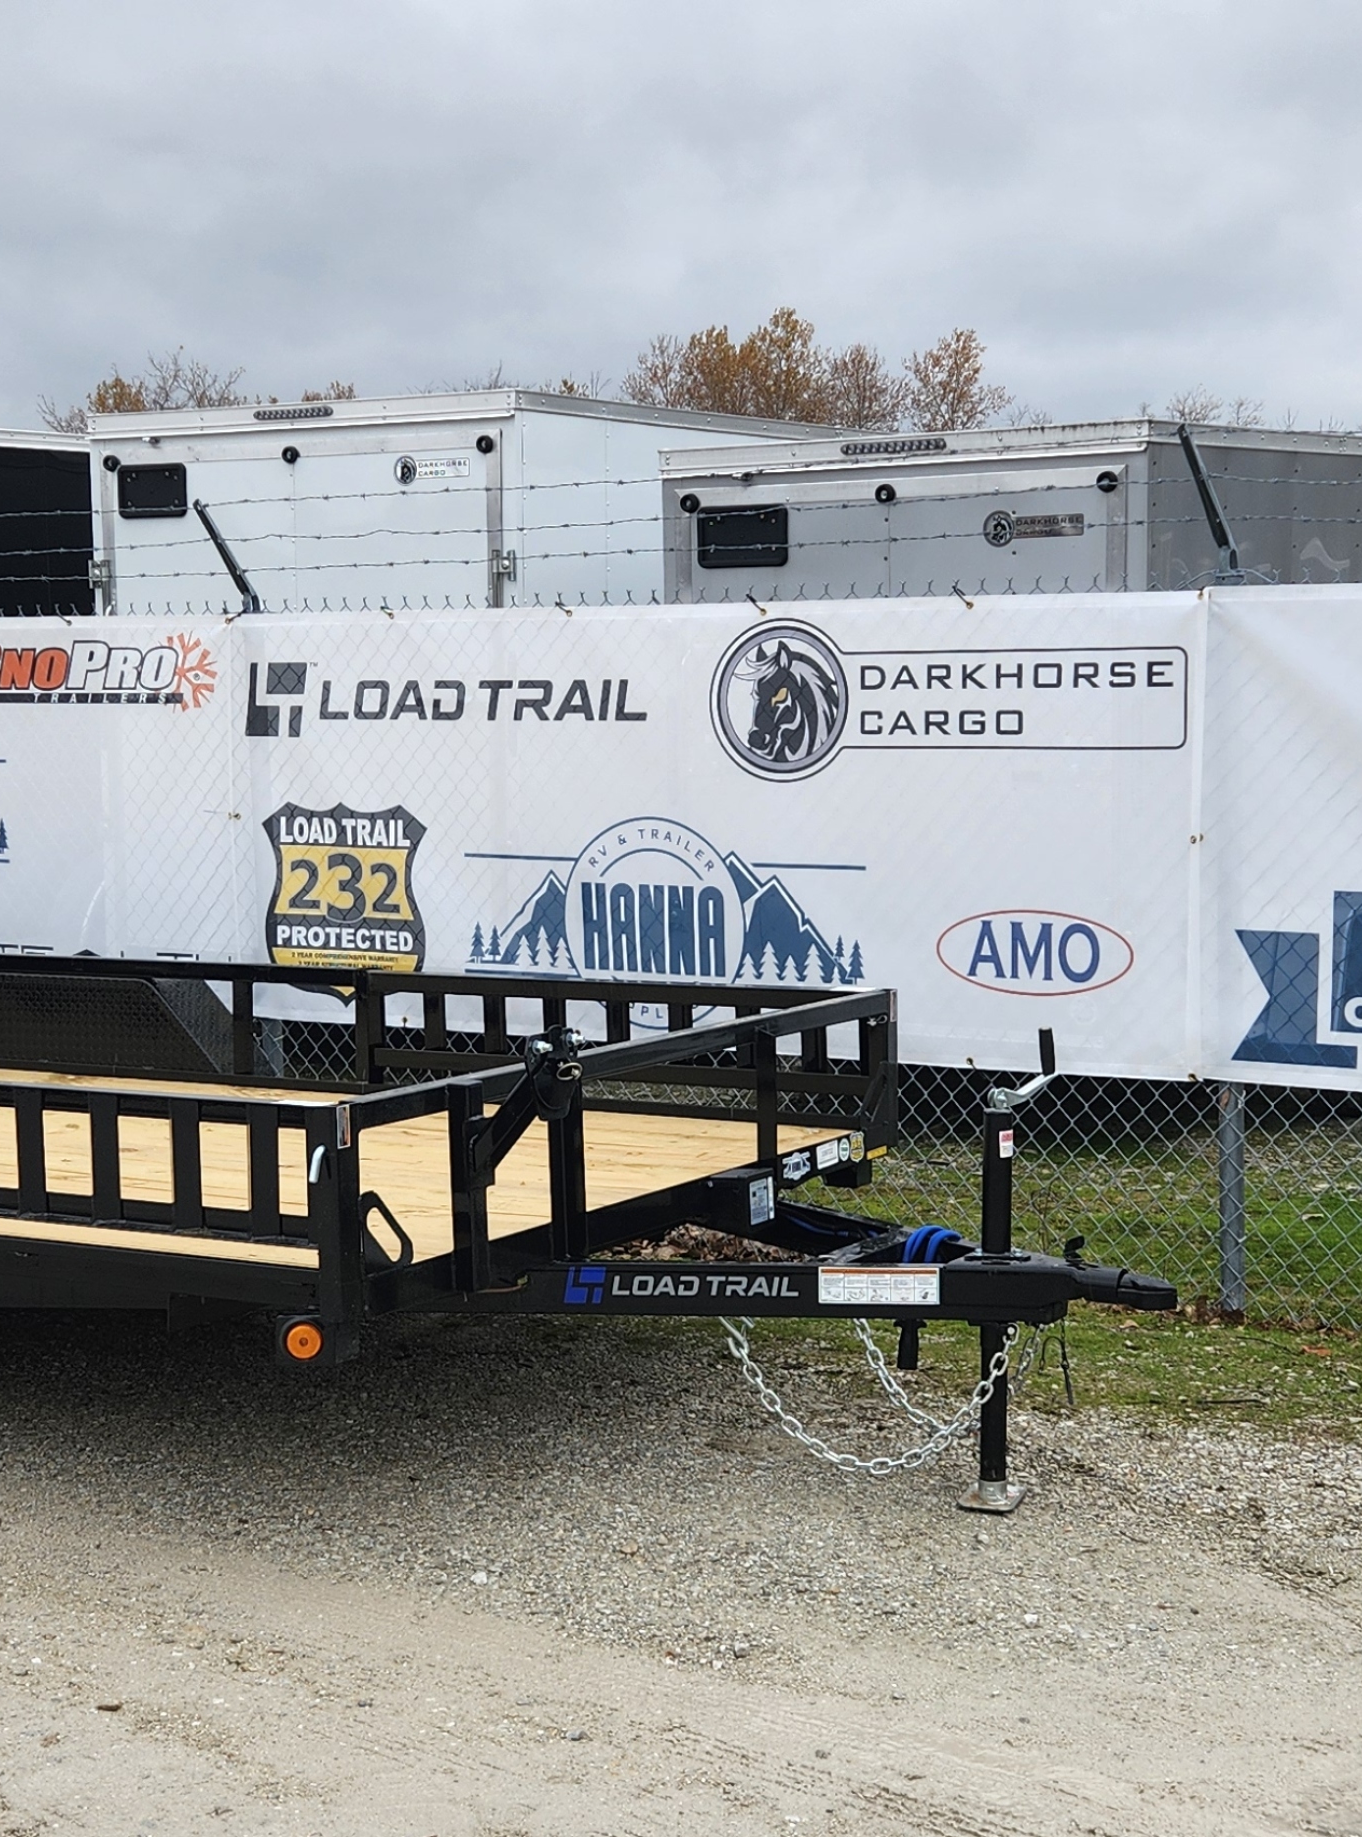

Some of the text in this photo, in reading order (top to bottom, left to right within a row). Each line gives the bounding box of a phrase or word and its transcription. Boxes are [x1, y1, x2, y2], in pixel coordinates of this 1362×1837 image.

[418, 460, 468, 469] DARKHORSE
[1016, 516, 1083, 527] DARKHORSE
[860, 660, 1174, 691] DARKHORSE
[33, 692, 167, 705] TRAILERS
[319, 678, 648, 722] LOAD TRAIL
[860, 709, 1024, 736] CARGO
[280, 815, 411, 847] LOAD TRAIL
[588, 828, 715, 872] RV & TRAILER
[288, 852, 401, 923] 232
[277, 924, 414, 952] PROTECTED
[580, 881, 727, 978] HANNA
[966, 919, 1101, 984] AMO
[611, 1275, 700, 1297] LOAD
[706, 1275, 800, 1297] TRAIL
